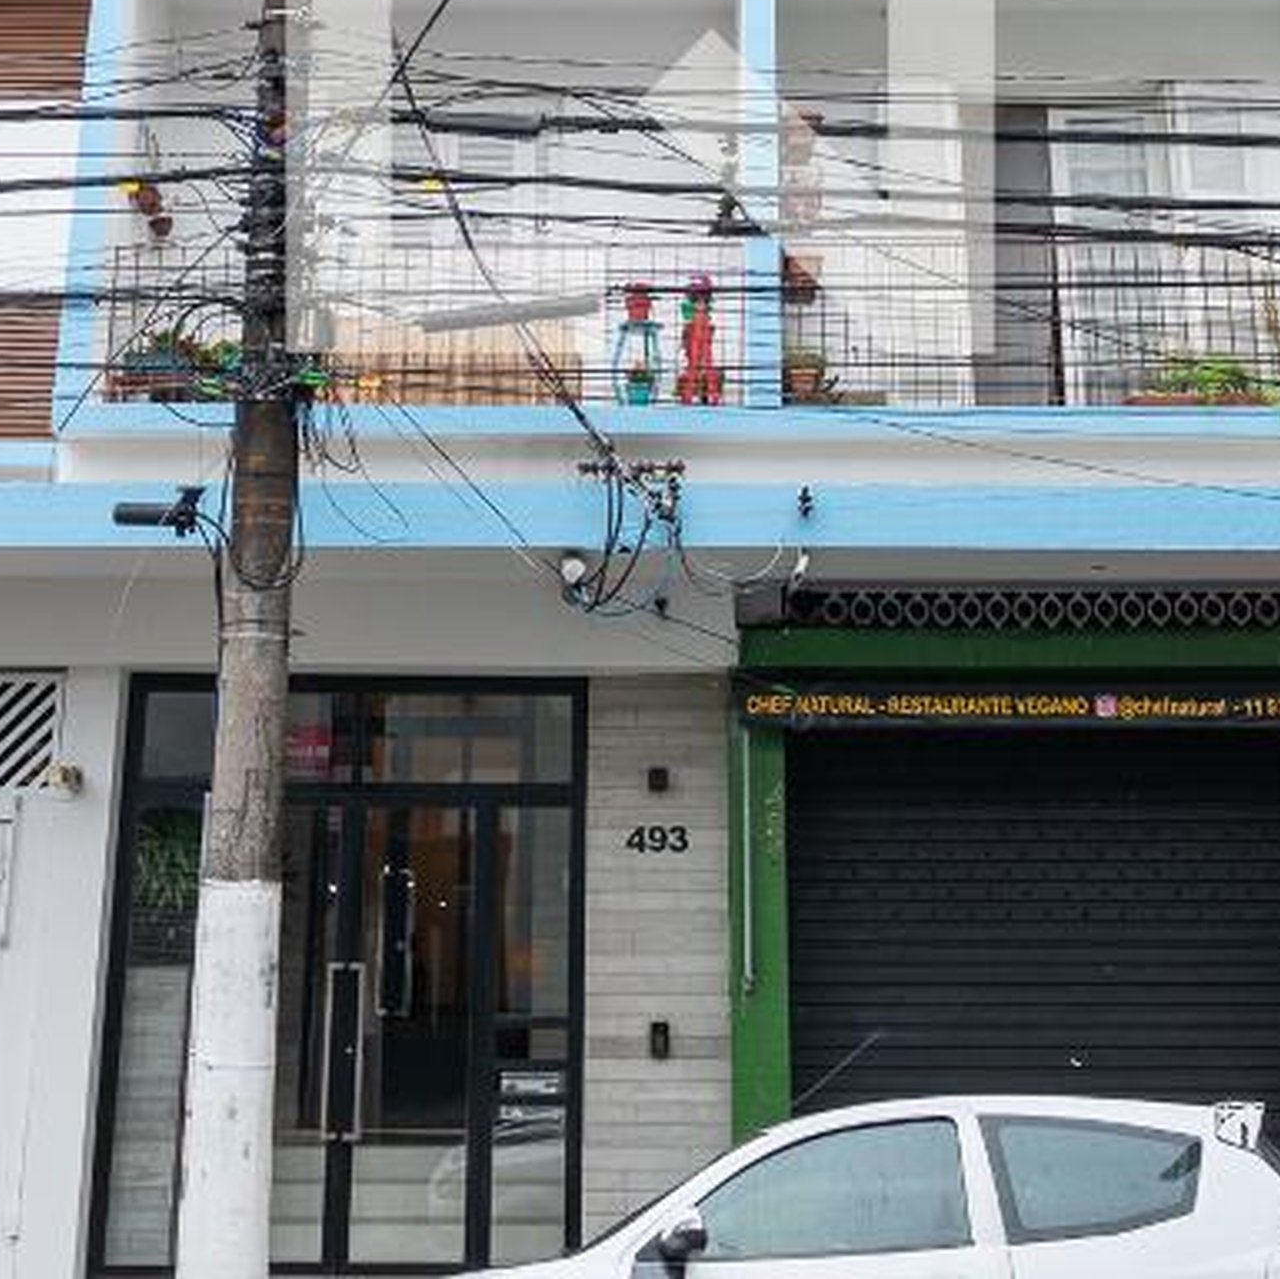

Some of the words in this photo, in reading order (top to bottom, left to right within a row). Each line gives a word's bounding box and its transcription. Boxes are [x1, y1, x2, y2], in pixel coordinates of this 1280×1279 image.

[746, 695, 793, 714] CHEF
[795, 695, 875, 715] NATURAL
[888, 696, 1012, 715] RESTAURANTE
[1015, 697, 1089, 715] VEGANO
[625, 825, 690, 853] 493
